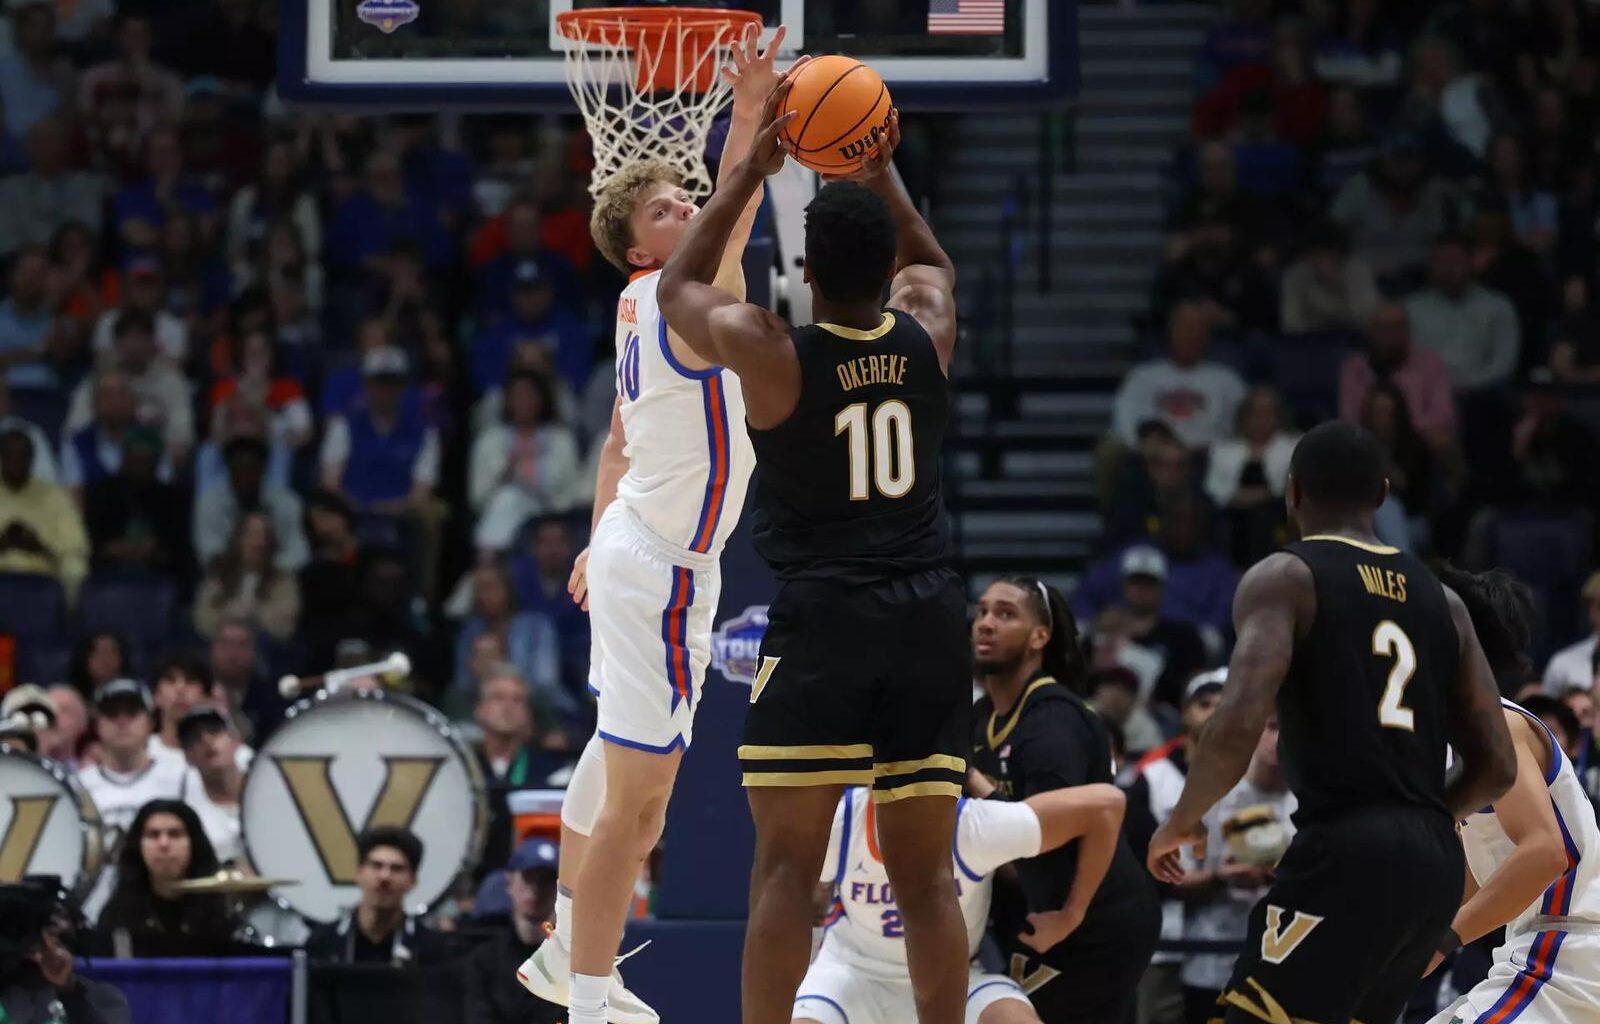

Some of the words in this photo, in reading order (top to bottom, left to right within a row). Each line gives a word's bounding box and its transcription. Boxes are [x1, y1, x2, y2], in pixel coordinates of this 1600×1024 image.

[836, 354, 908, 392] OKEREKE
[834, 399, 916, 501] 10
[1356, 564, 1408, 603] MILES
[1371, 619, 1417, 732] 2
[270, 755, 448, 886] V
[1261, 903, 1325, 965] V
[1010, 952, 1062, 997] V
